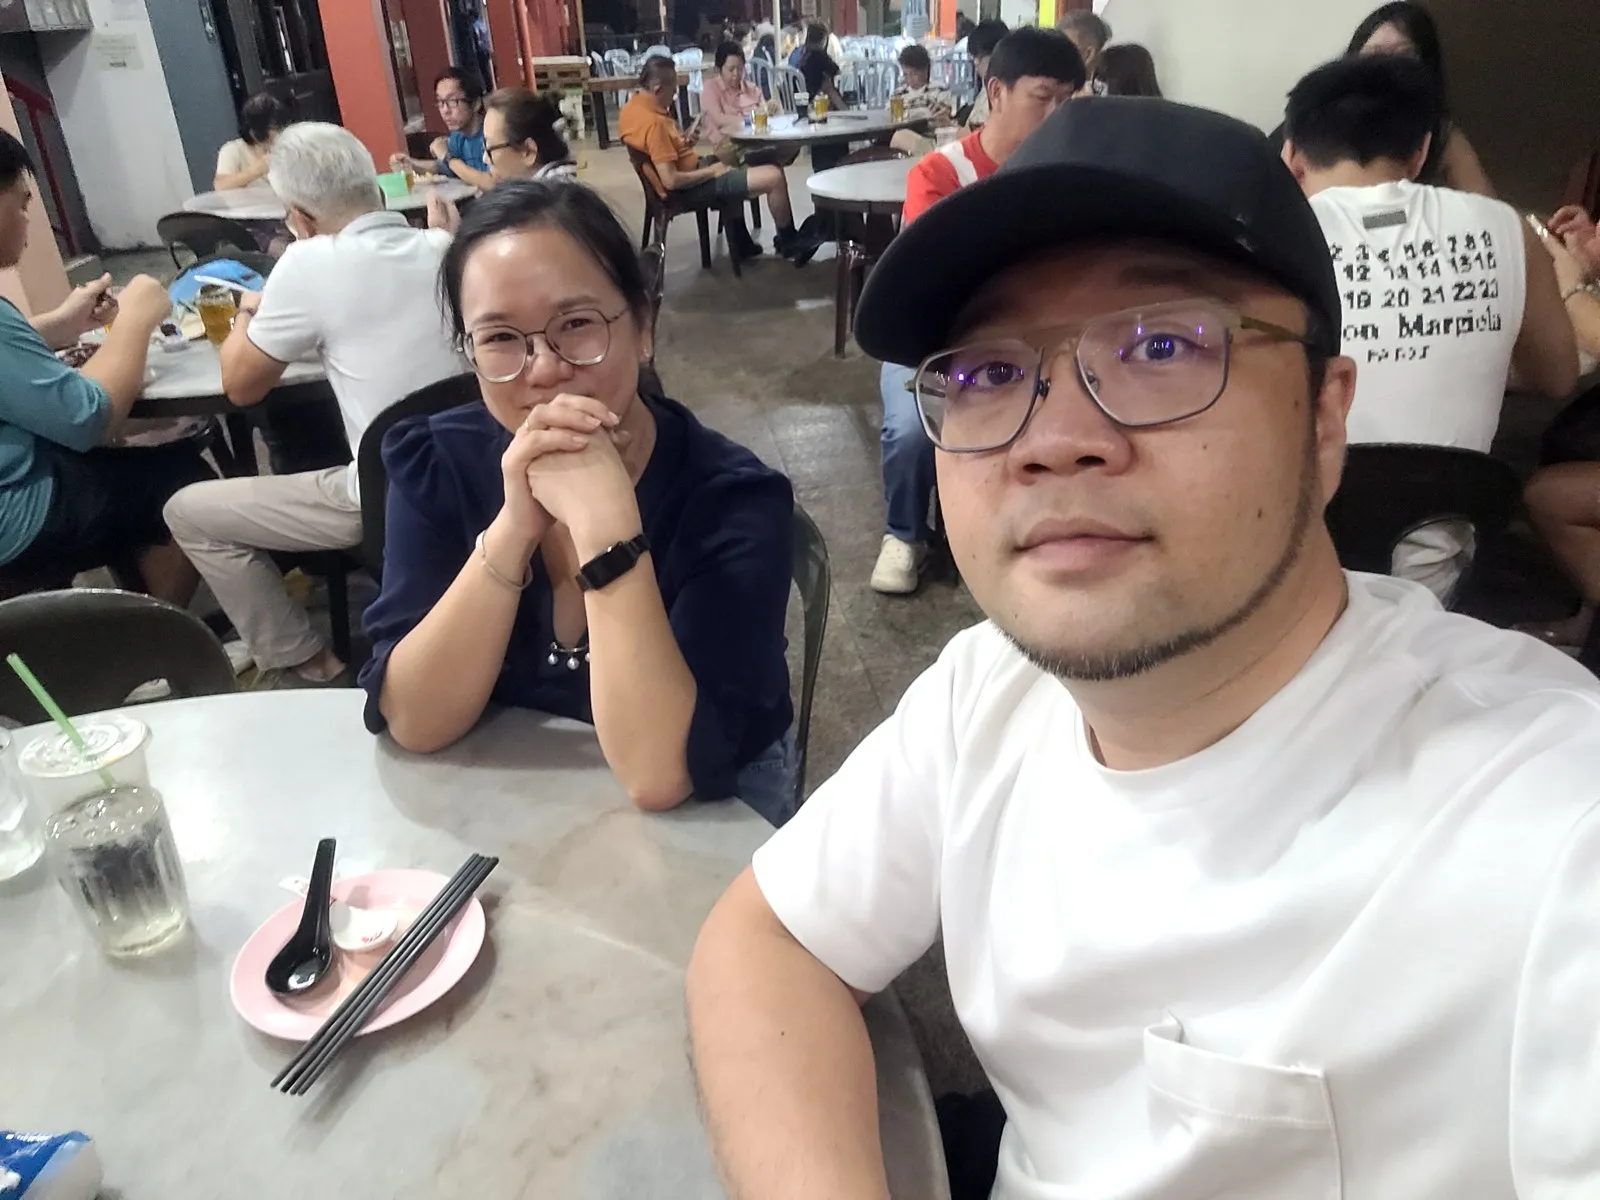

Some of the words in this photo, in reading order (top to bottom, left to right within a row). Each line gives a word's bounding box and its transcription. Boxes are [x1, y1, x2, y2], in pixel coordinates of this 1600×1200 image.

[1381, 287, 1409, 309] 20
[1421, 285, 1445, 304] 21
[1452, 280, 1476, 302] 22
